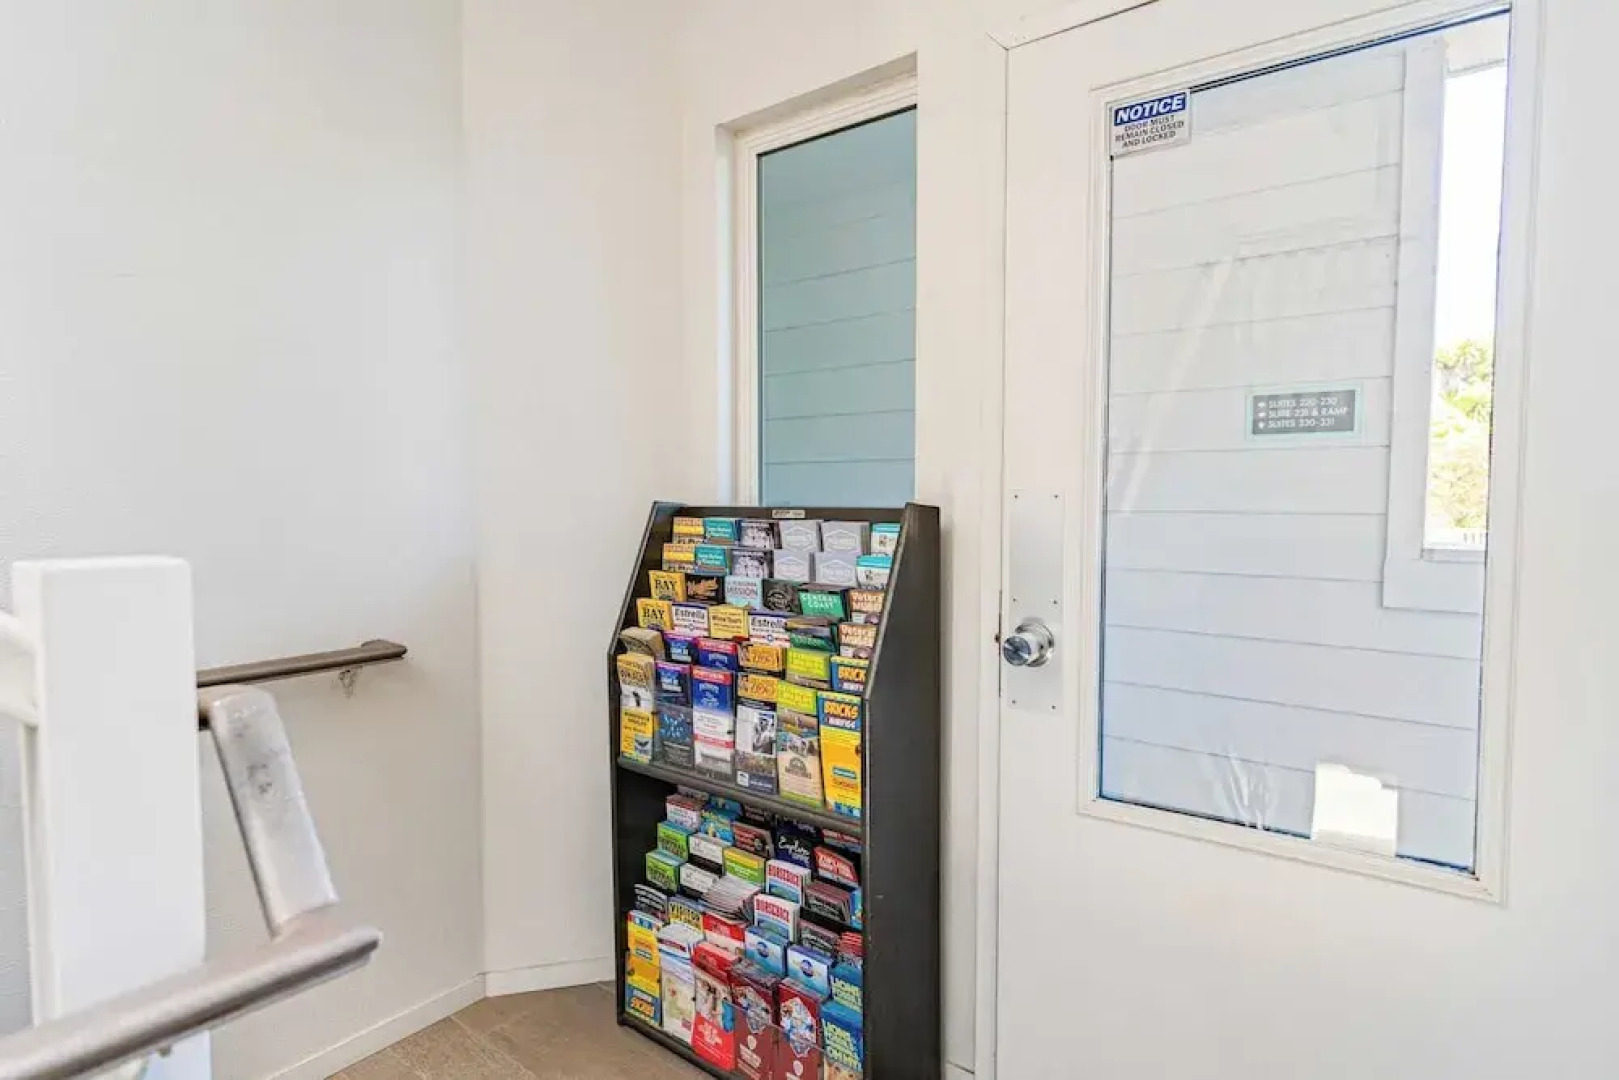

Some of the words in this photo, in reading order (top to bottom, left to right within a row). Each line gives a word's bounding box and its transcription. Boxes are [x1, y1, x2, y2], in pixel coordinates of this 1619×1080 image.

[1117, 95, 1184, 123] NOTICE
[1124, 121, 1149, 132] DOOR
[1150, 114, 1175, 126] MUST
[1115, 128, 1149, 142] REMAIN
[1150, 121, 1184, 134] CLOSED
[1123, 138, 1141, 147] AND
[1142, 130, 1176, 145] LOCKED
[1268, 399, 1296, 409] SUITES
[1322, 406, 1348, 416] RAMP
[1268, 419, 1296, 428] SUITES
[674, 608, 705, 620] Estrella
